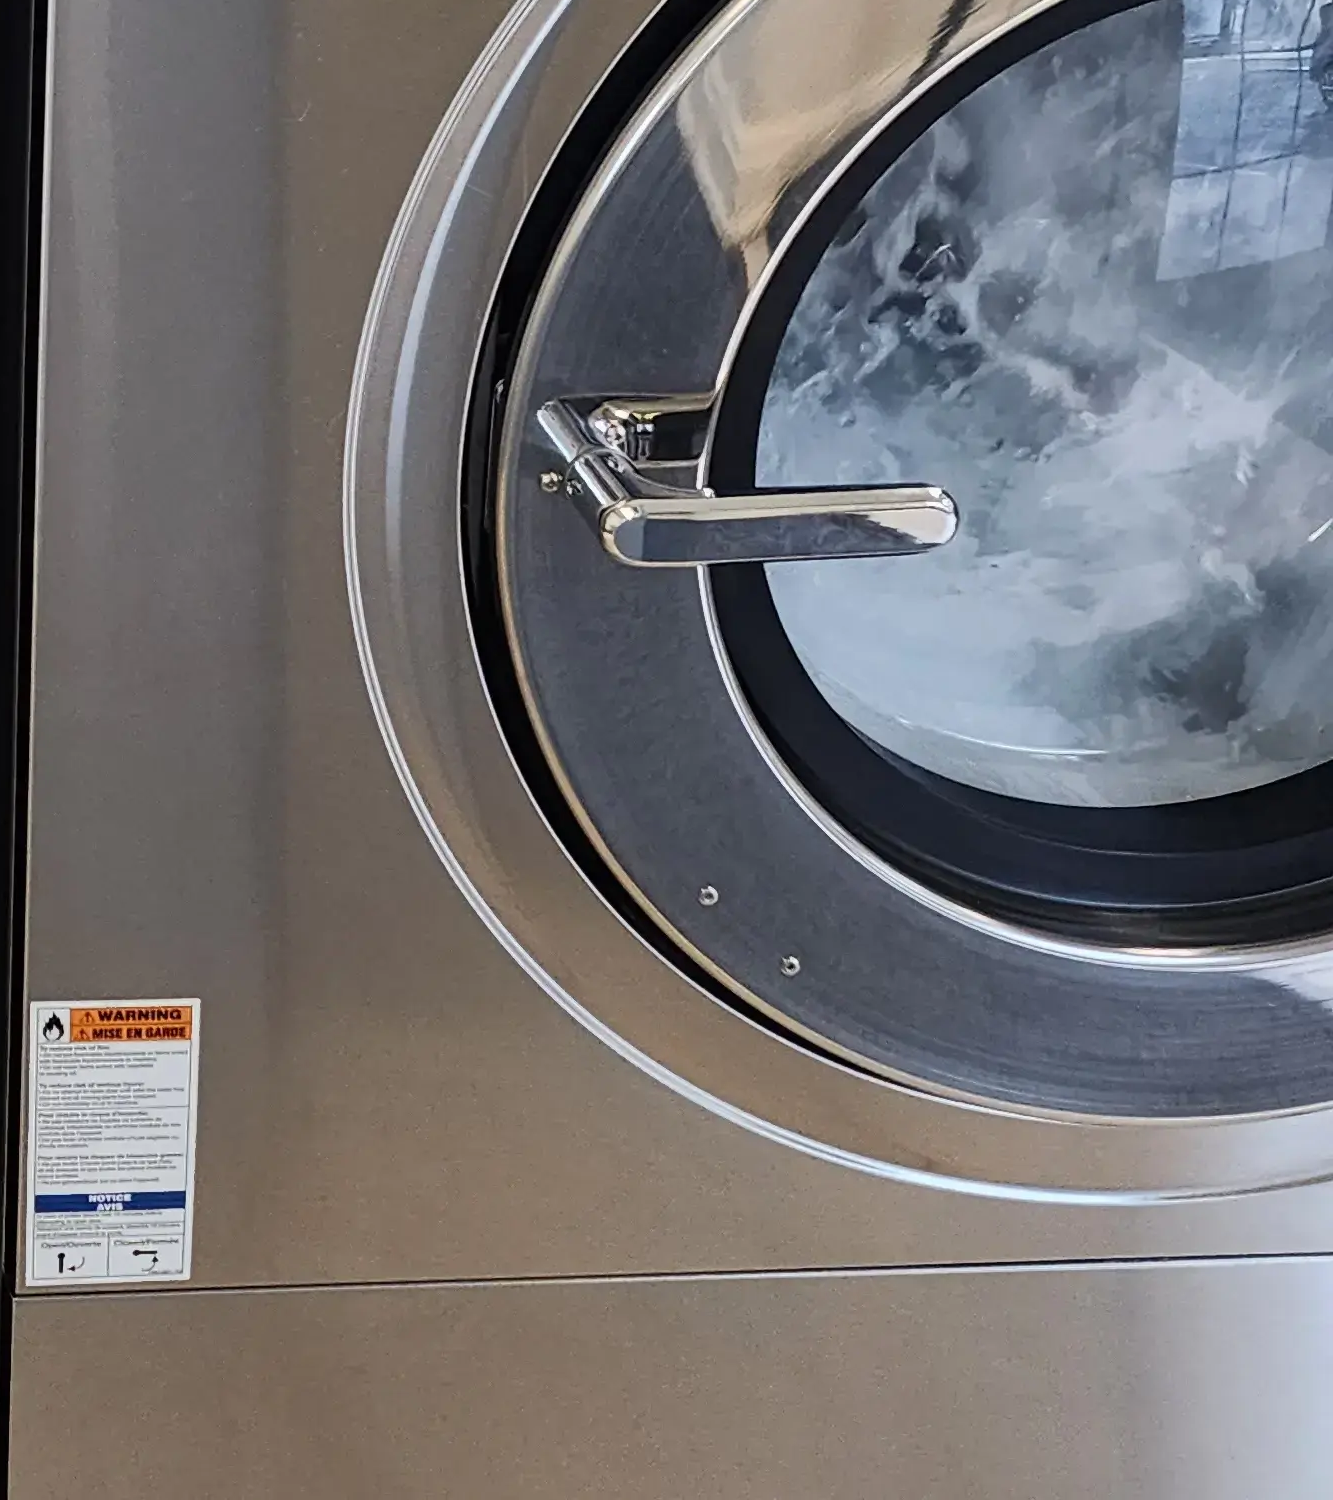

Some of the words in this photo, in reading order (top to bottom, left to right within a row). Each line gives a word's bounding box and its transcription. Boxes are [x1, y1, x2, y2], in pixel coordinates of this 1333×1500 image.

[98, 1009, 182, 1022] WARNING
[91, 1027, 122, 1039] MISE
[126, 1027, 143, 1038] EN
[145, 1026, 186, 1038] GARDE
[88, 1193, 132, 1202] NOTICE
[96, 1202, 123, 1211] AVIS
